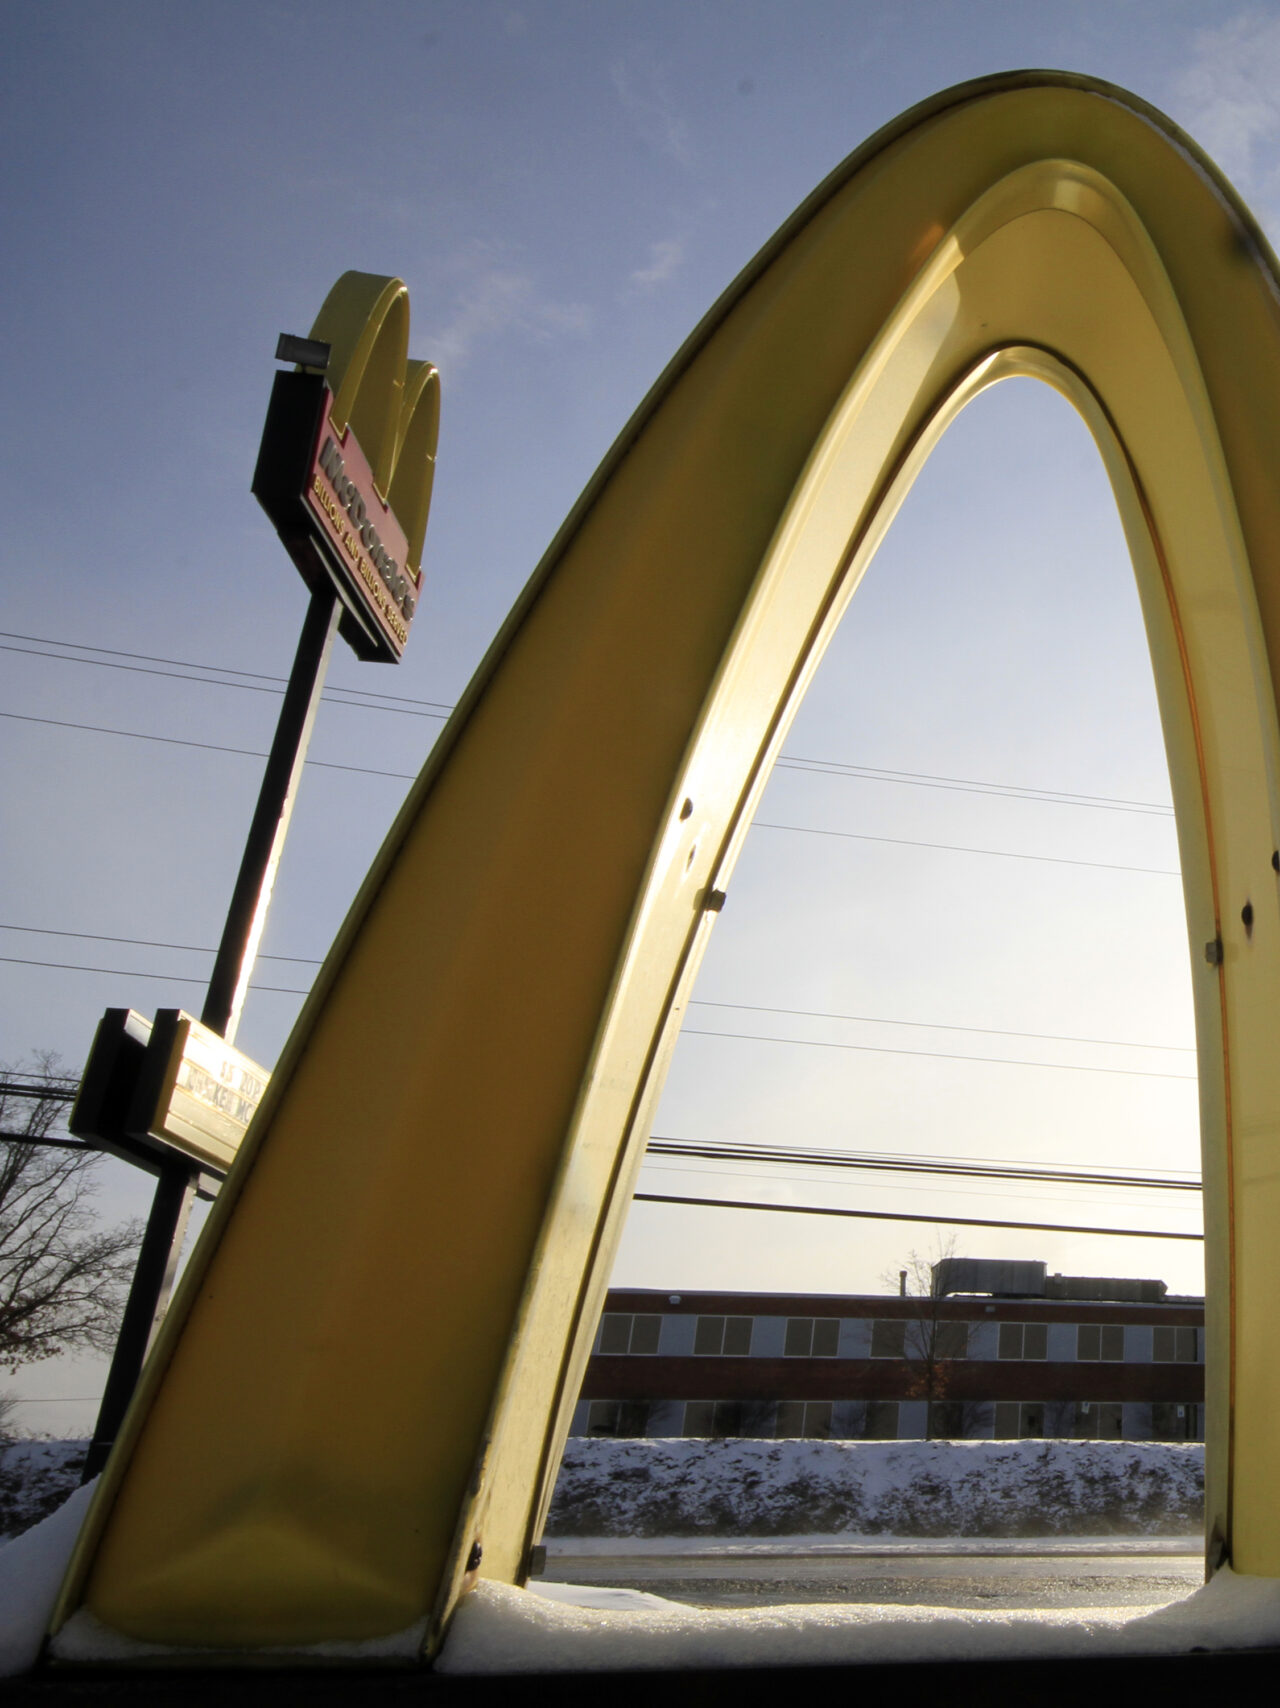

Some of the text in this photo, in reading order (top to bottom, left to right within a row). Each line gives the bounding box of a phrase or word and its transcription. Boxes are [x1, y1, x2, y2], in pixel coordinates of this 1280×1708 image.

[313, 475, 408, 646] BILLIONS AND BILLIONS SERVED
